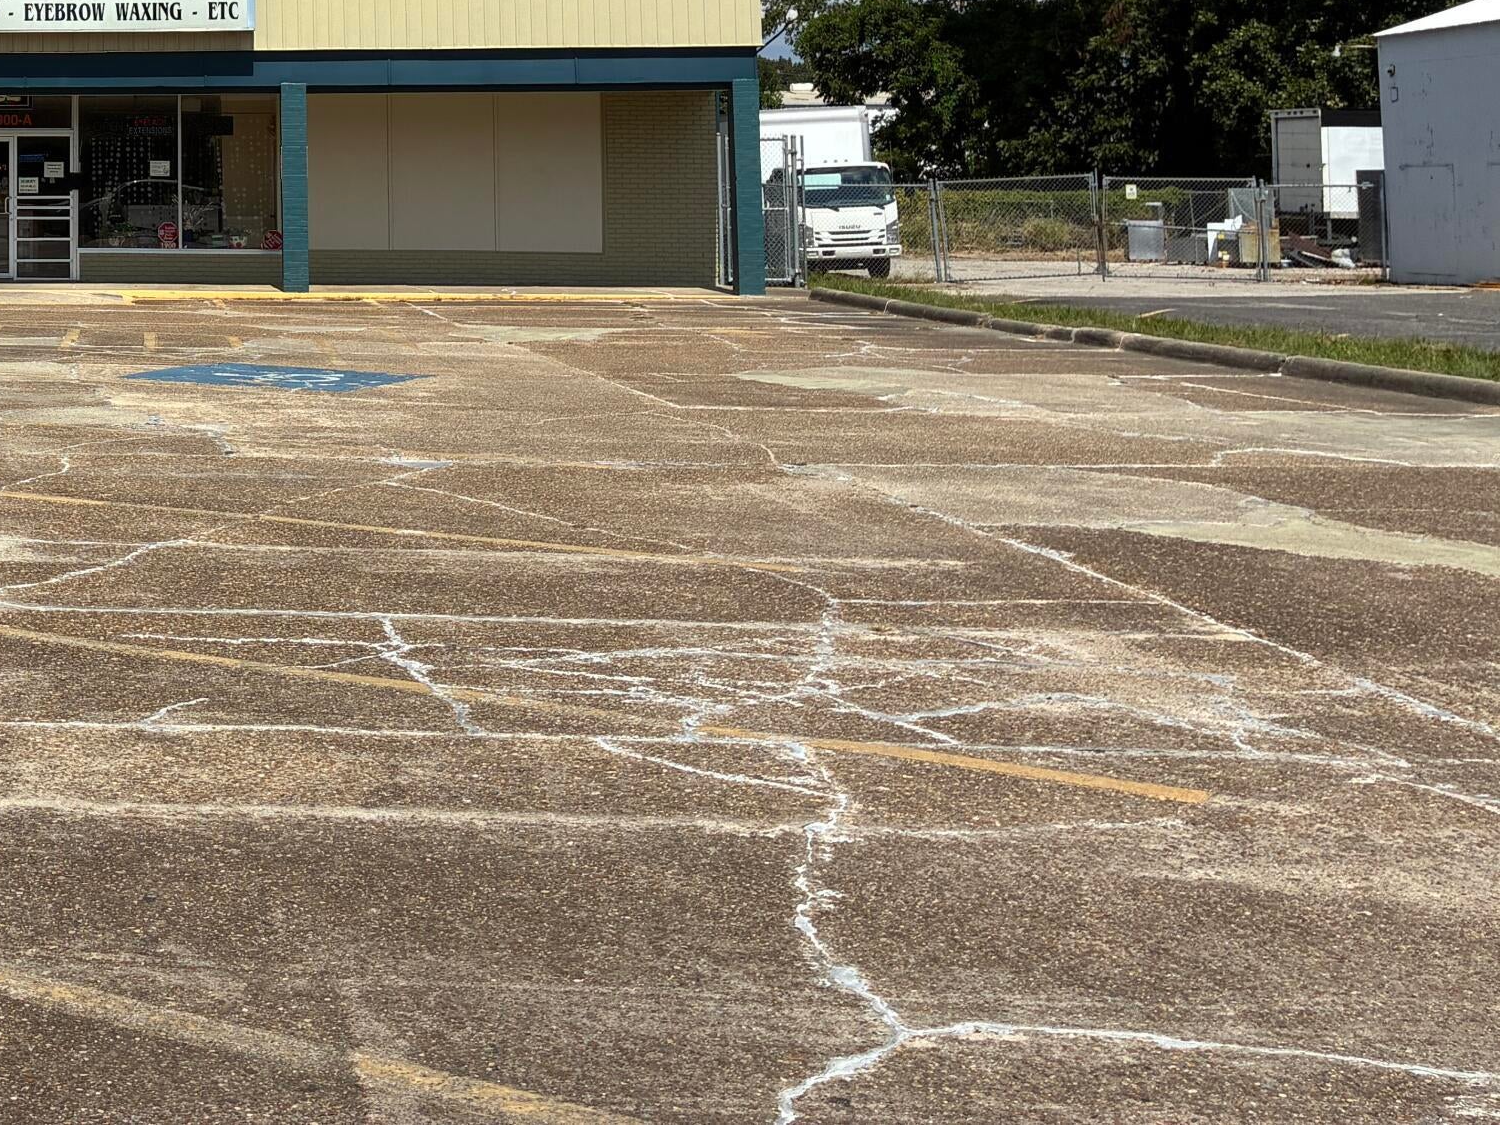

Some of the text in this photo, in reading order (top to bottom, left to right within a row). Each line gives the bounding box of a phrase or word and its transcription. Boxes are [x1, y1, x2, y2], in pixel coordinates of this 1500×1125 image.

[24, 2, 106, 22] EYEBROW
[116, 1, 182, 21] WAXING
[208, 1, 240, 20] ETC
